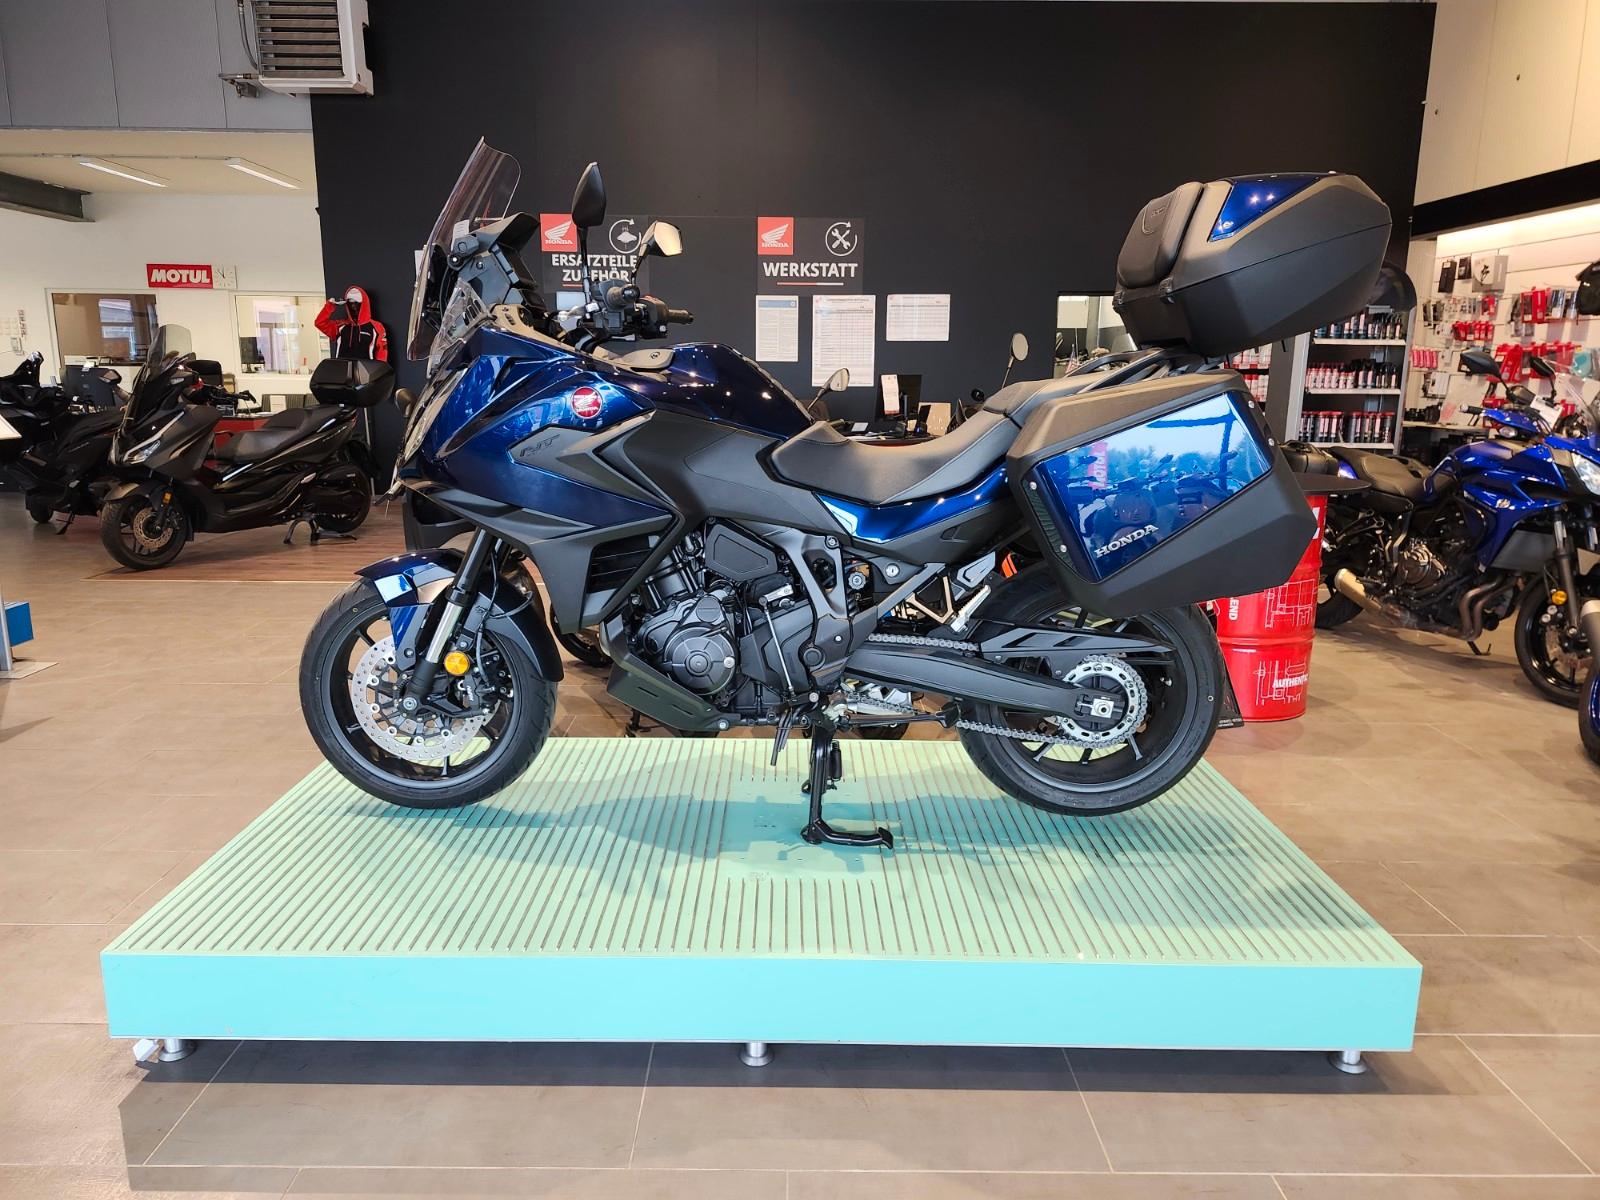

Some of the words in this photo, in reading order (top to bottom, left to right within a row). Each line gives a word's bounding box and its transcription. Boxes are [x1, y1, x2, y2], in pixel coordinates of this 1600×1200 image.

[551, 253, 638, 267] ERSATZTEILE
[151, 268, 211, 283] MOTUL
[562, 267, 630, 282] ZUEHÖR
[763, 262, 858, 278] WERKSTATT
[1093, 524, 1159, 558] HONDA
[1228, 597, 1240, 621] END
